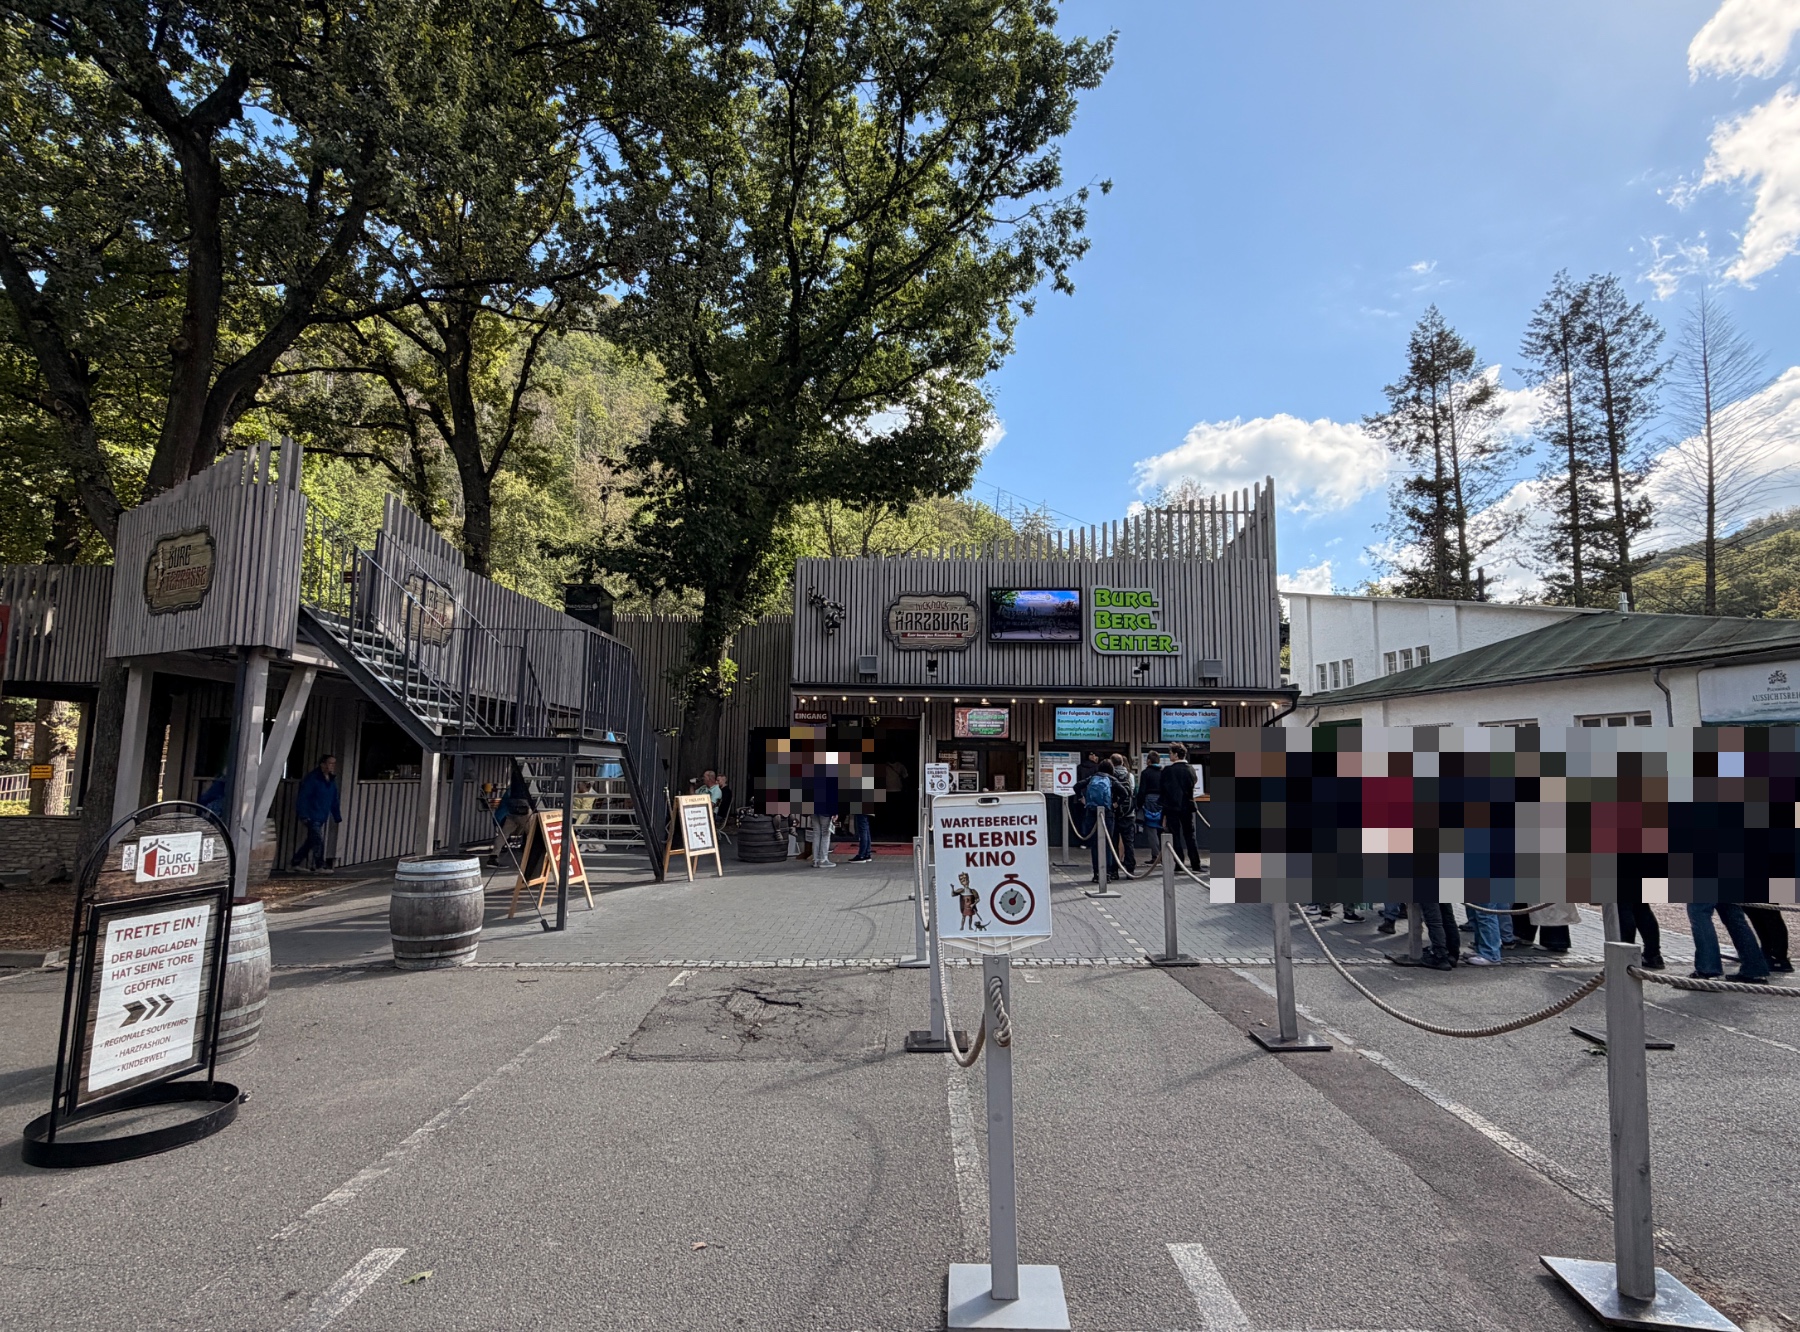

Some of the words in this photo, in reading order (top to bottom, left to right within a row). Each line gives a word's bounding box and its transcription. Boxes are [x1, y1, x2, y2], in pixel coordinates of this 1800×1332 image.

[895, 611, 969, 631] HARZBURG
[941, 815, 1038, 828] WARTEBEREICH
[943, 830, 1038, 848] ERLEBNIS
[158, 852, 192, 866] BURG
[966, 850, 1016, 868] KINO
[157, 863, 196, 878] LADEN
[115, 921, 171, 942] TRETET
[111, 951, 134, 964] DER
[134, 938, 198, 958] BURGLADEN
[112, 967, 132, 980] HAT
[134, 960, 165, 975] SEINE
[167, 954, 194, 968] TORE
[124, 974, 178, 996] GEÖFFNET
[104, 1029, 146, 1048] REGIONALE
[146, 1018, 189, 1035] SOUVENIRS
